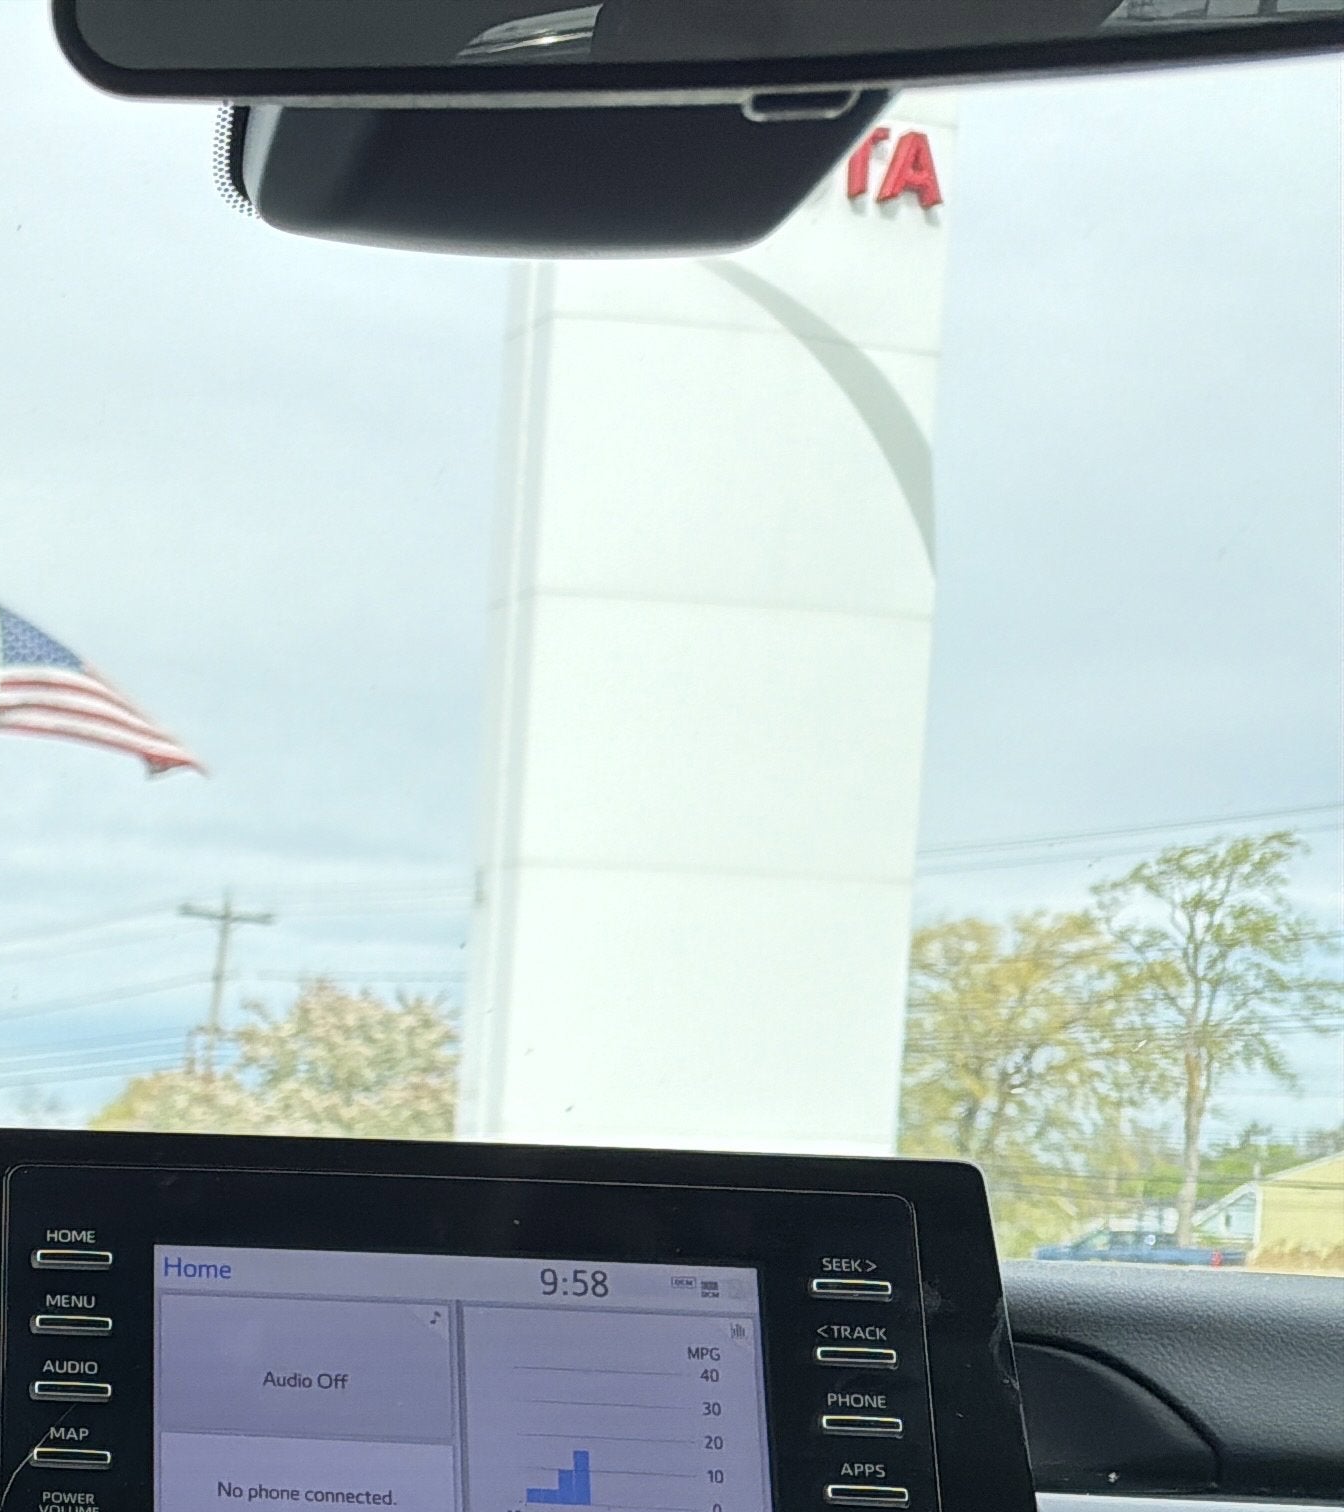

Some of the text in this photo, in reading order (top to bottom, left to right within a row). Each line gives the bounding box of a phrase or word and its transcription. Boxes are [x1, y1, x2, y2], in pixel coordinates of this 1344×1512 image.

[46, 1229, 97, 1244] HOME
[163, 1256, 232, 1279] Home
[540, 1268, 609, 1298] 9:58
[45, 1293, 96, 1309] MENU
[687, 1346, 721, 1362] MPG
[42, 1360, 99, 1375] AUDIO
[263, 1371, 350, 1390] Audio Off
[700, 1368, 720, 1383] 40
[827, 1393, 887, 1409] PHONE
[703, 1402, 722, 1417] 30
[49, 1426, 90, 1441] MAP
[704, 1436, 724, 1450] 20
[708, 1469, 725, 1484] 10
[840, 1462, 886, 1479] APPS
[42, 1490, 95, 1504] POWER
[217, 1481, 398, 1506] No phone connected.
